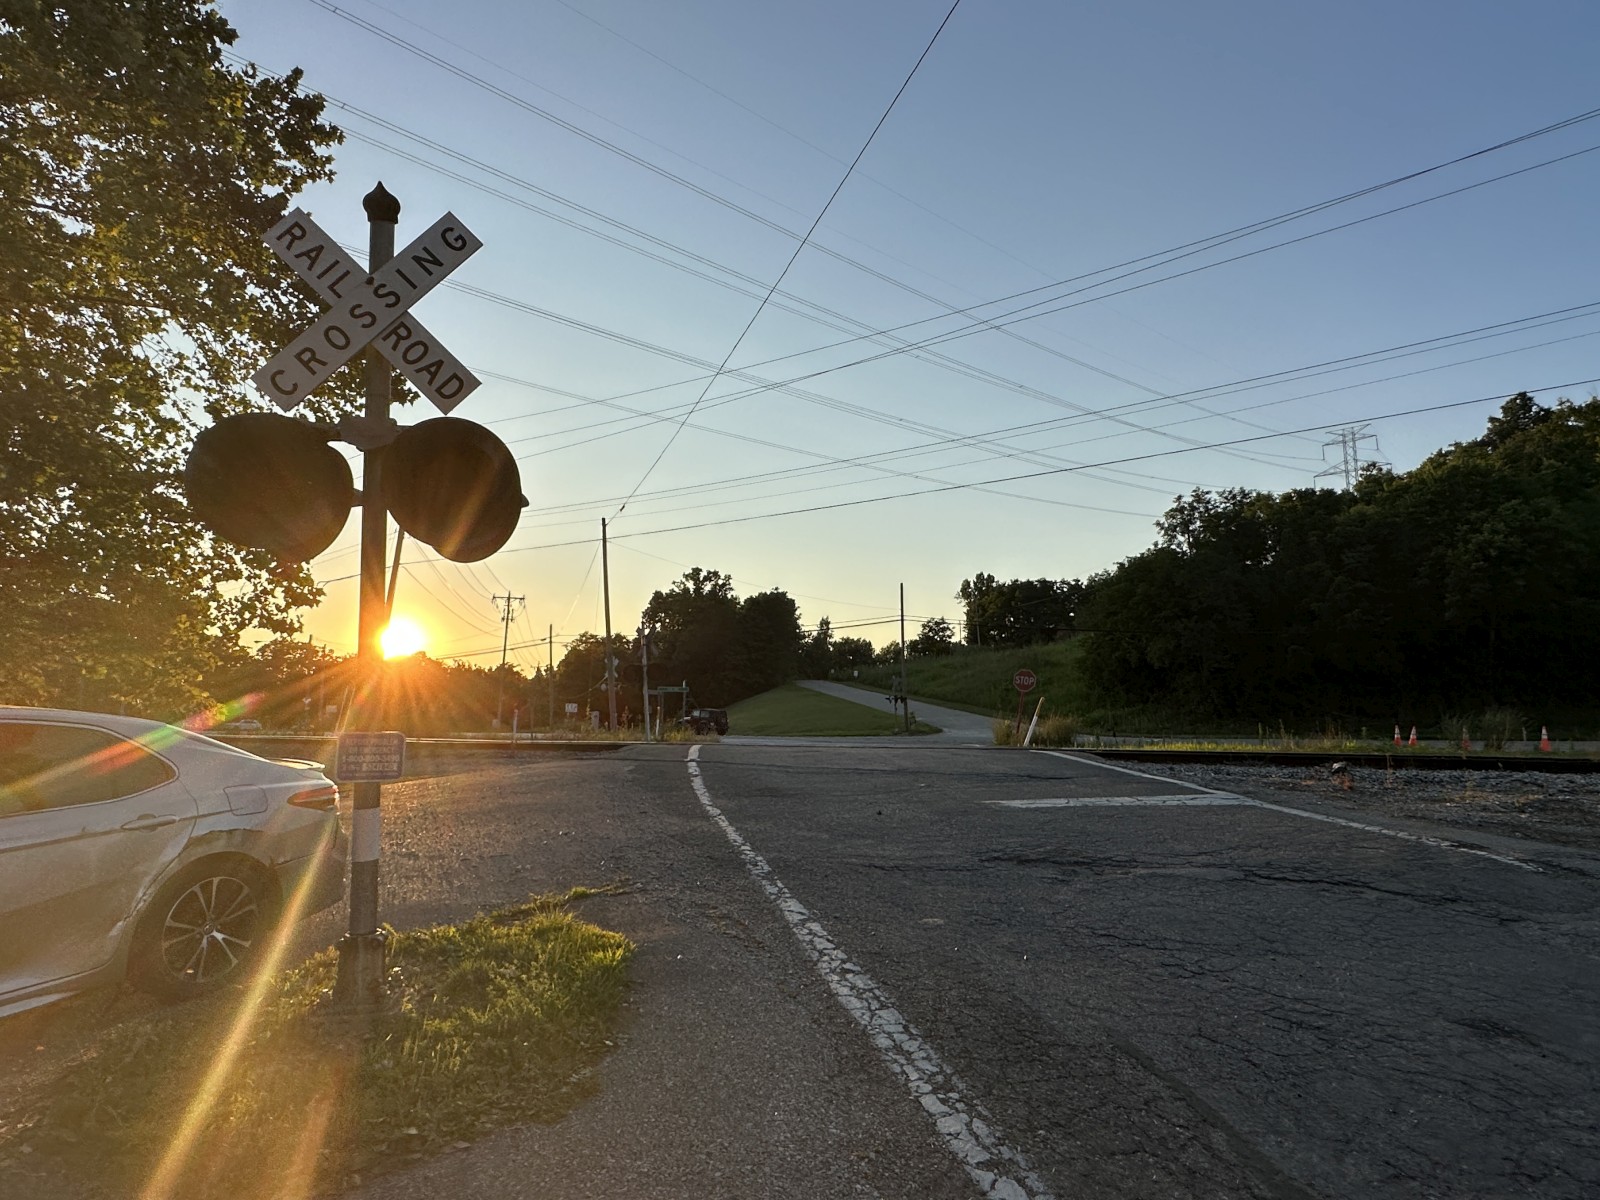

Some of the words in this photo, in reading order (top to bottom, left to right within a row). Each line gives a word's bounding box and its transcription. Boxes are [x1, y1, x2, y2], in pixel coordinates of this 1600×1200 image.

[270, 227, 467, 396] CROSSING
[276, 221, 350, 299] RAIL
[381, 321, 464, 400] ROAD
[1015, 676, 1035, 685] STOP
